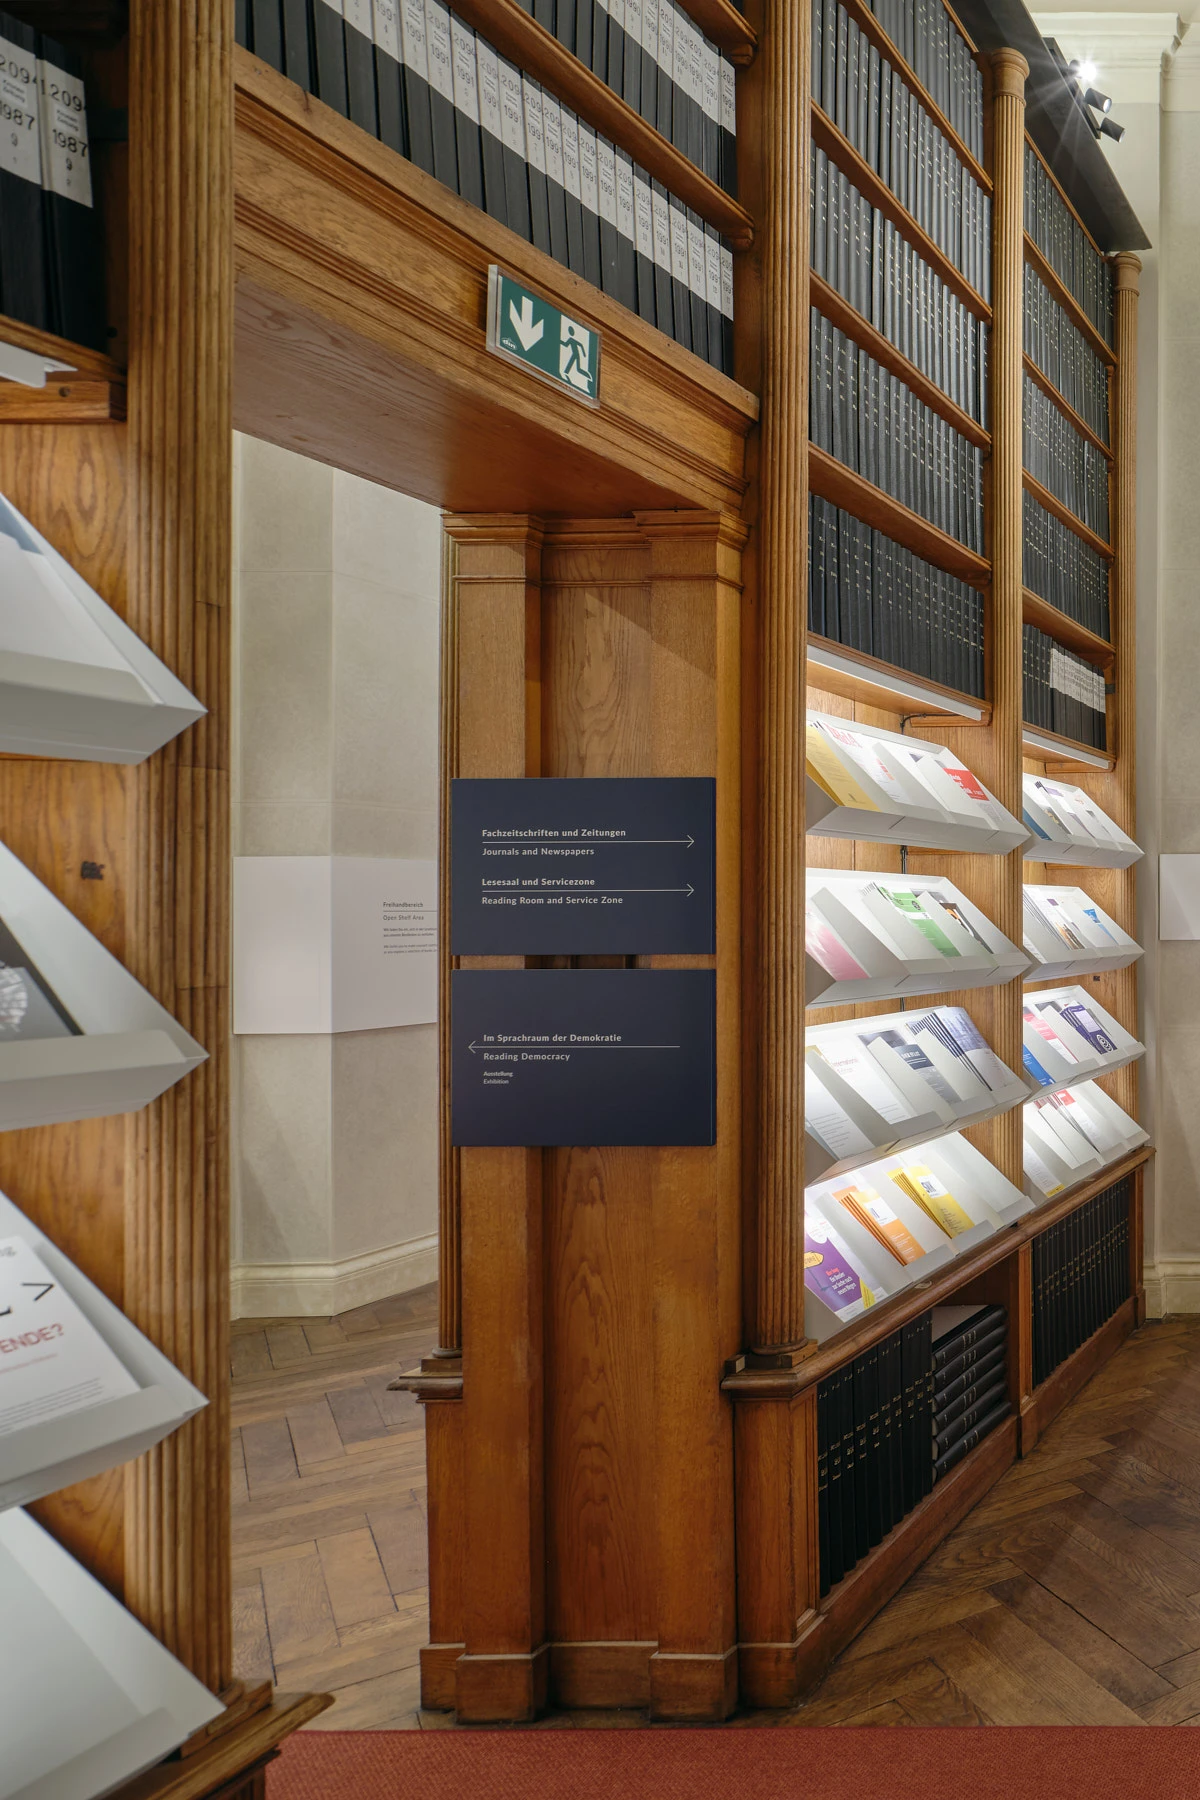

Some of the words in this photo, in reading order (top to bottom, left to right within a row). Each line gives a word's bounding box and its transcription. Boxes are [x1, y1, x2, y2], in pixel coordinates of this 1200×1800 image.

[479, 58, 498, 79] 209
[501, 74, 520, 95] 209
[483, 89, 497, 107] 199
[52, 129, 88, 157] 1987
[482, 829, 559, 837] Fachzeitschriften
[562, 829, 578, 837] und
[581, 829, 626, 838] Zeitungen
[482, 848, 519, 856] Journals
[541, 847, 595, 857] Newspapers
[482, 878, 519, 886] Lesesaal
[522, 878, 539, 886] und
[541, 878, 595, 886] Servicezone
[482, 897, 517, 906] Reading
[520, 897, 544, 905] Room
[483, 1034, 494, 1042] Im
[497, 1034, 549, 1044] Sprachraum
[552, 1034, 567, 1042] der
[570, 1034, 622, 1042] Demokratie
[483, 1053, 518, 1062] Reading
[521, 1053, 570, 1062] Democracy
